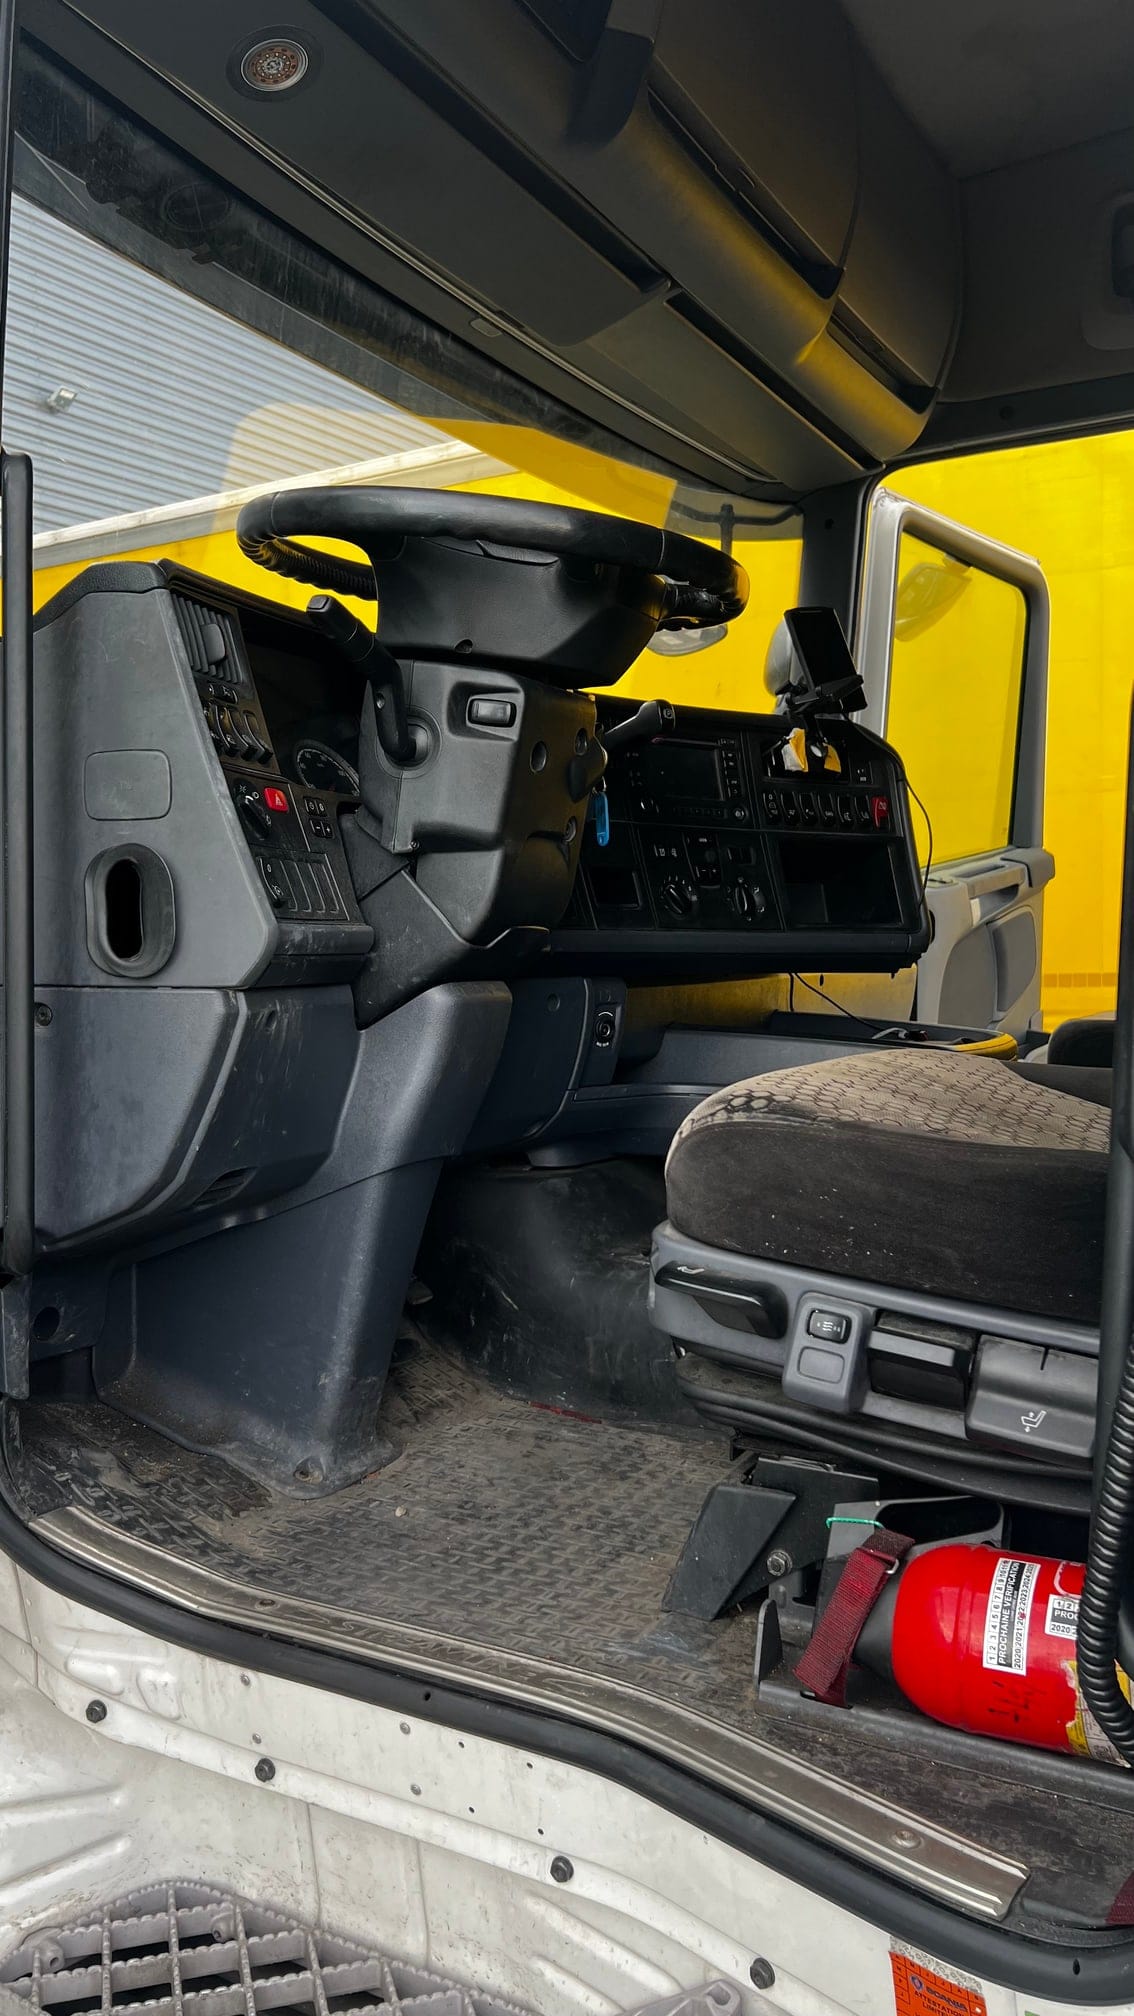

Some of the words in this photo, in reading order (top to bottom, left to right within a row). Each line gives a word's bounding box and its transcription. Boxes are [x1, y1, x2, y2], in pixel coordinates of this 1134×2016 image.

[1003, 1562, 1019, 1607] VERIFICATION
[998, 1609, 1010, 1664] PROCHAINE
[1015, 1628, 1023, 1646] 2021
[1019, 1589, 1028, 1605] 2023
[1051, 1623, 1071, 1634] 2020
[1054, 1609, 1078, 1621] PROC
